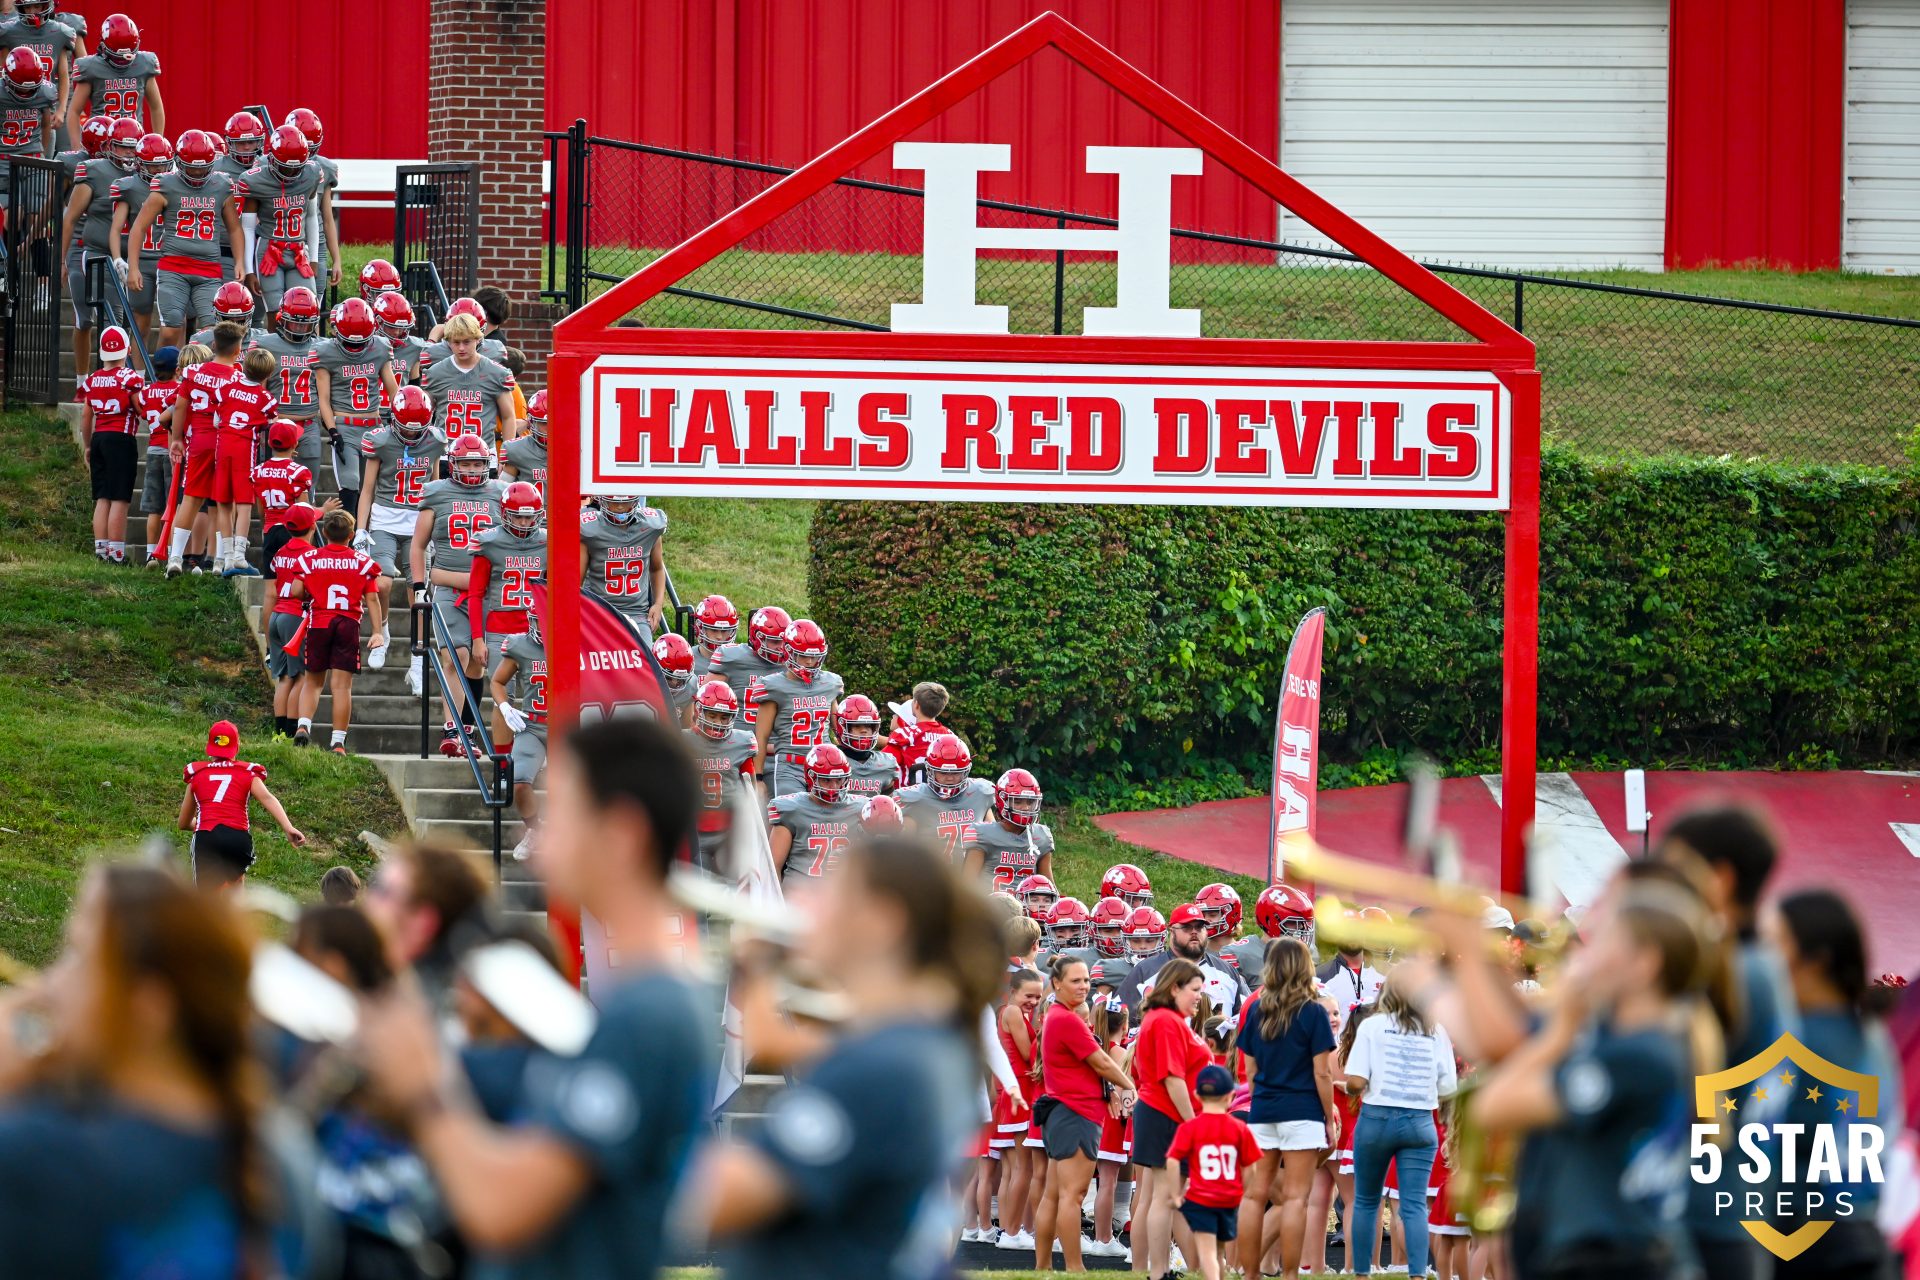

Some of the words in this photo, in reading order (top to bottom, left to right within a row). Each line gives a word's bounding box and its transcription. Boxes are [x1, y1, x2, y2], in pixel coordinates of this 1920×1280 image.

[105, 78, 137, 90] HALLS
[6, 109, 38, 119] HALLS
[103, 91, 139, 118] 29
[1, 120, 38, 145] 37
[181, 197, 216, 208] HALLS
[175, 209, 215, 240] 28
[273, 207, 304, 238] 10
[890, 142, 1203, 338] H
[281, 355, 309, 366] HALL
[342, 363, 375, 377] HALLS
[194, 373, 228, 388] COPELAN
[280, 368, 312, 404] 14
[229, 388, 258, 404] ROSAS
[350, 377, 369, 410] 8
[448, 390, 482, 401] HALLS
[445, 403, 483, 440] 65
[613, 387, 912, 469] HALLS
[940, 394, 1124, 473] RED
[1152, 397, 1480, 479] DEVILS
[397, 457, 429, 469] HLS
[393, 470, 427, 505] 15
[452, 501, 489, 512] HALLS
[311, 558, 360, 570] MORROW
[505, 556, 541, 568] HALLS
[608, 546, 643, 559] HALLS
[501, 569, 542, 607] 25
[604, 559, 644, 596] 52
[327, 584, 349, 610] 6
[589, 650, 643, 671] DEVILS
[530, 673, 548, 711] 3
[793, 696, 827, 709] HALLS
[791, 709, 831, 746] 27
[209, 774, 233, 803] 7
[703, 772, 722, 808] 9
[939, 809, 975, 824] HALLS
[811, 823, 848, 835] HALLS
[1000, 851, 1036, 865] HALLS
[1199, 1144, 1238, 1180] 60
